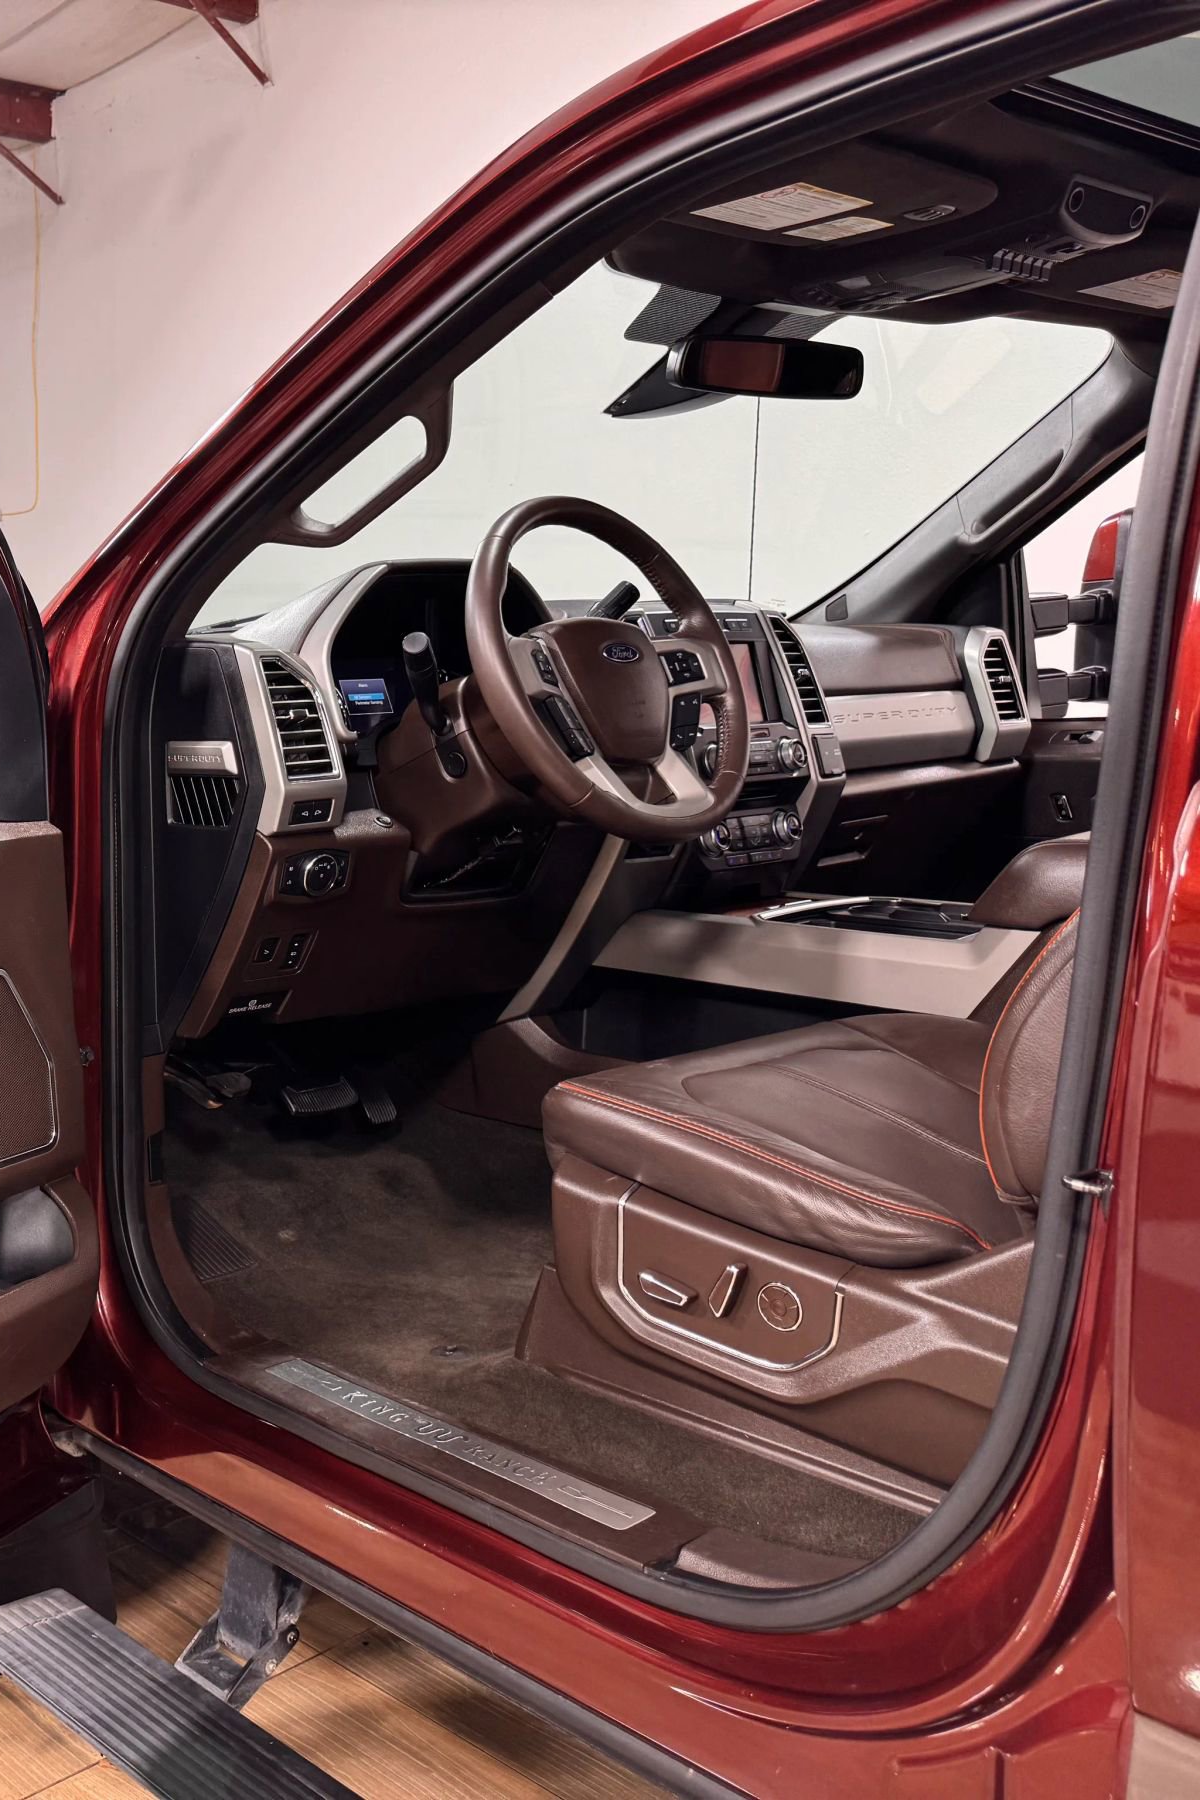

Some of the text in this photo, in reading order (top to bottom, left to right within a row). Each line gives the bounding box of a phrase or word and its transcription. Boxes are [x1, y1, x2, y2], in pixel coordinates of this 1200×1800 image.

[611, 646, 634, 659] Ford
[247, 1002, 273, 1011] RELEASE
[342, 1390, 557, 1486] KING RANCH
